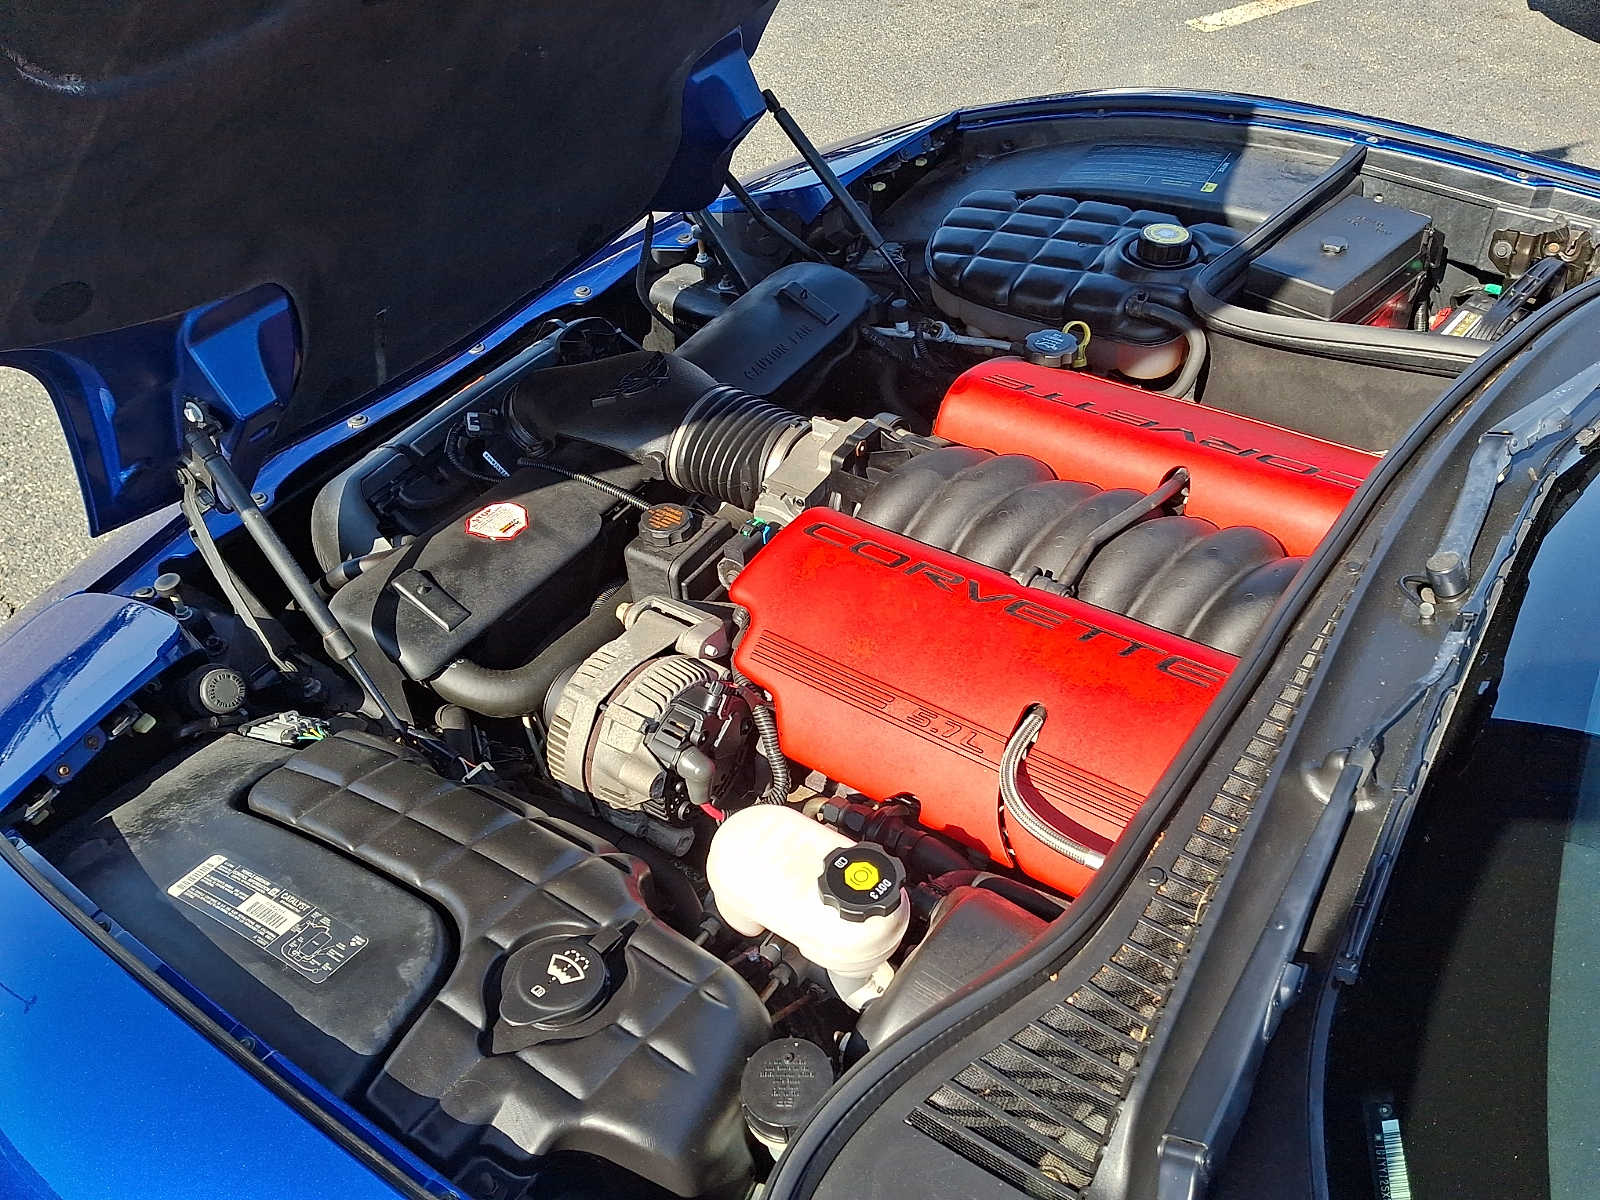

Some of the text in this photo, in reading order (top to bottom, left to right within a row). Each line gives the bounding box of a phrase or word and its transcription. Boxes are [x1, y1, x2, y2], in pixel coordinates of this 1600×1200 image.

[803, 522, 1229, 689] CORVETTE
[906, 707, 984, 754] 5.7L
[280, 892, 311, 912] CATALYST
[869, 878, 892, 900] DOT 3
[1375, 1145, 1391, 1200] 1G1YY12SX
